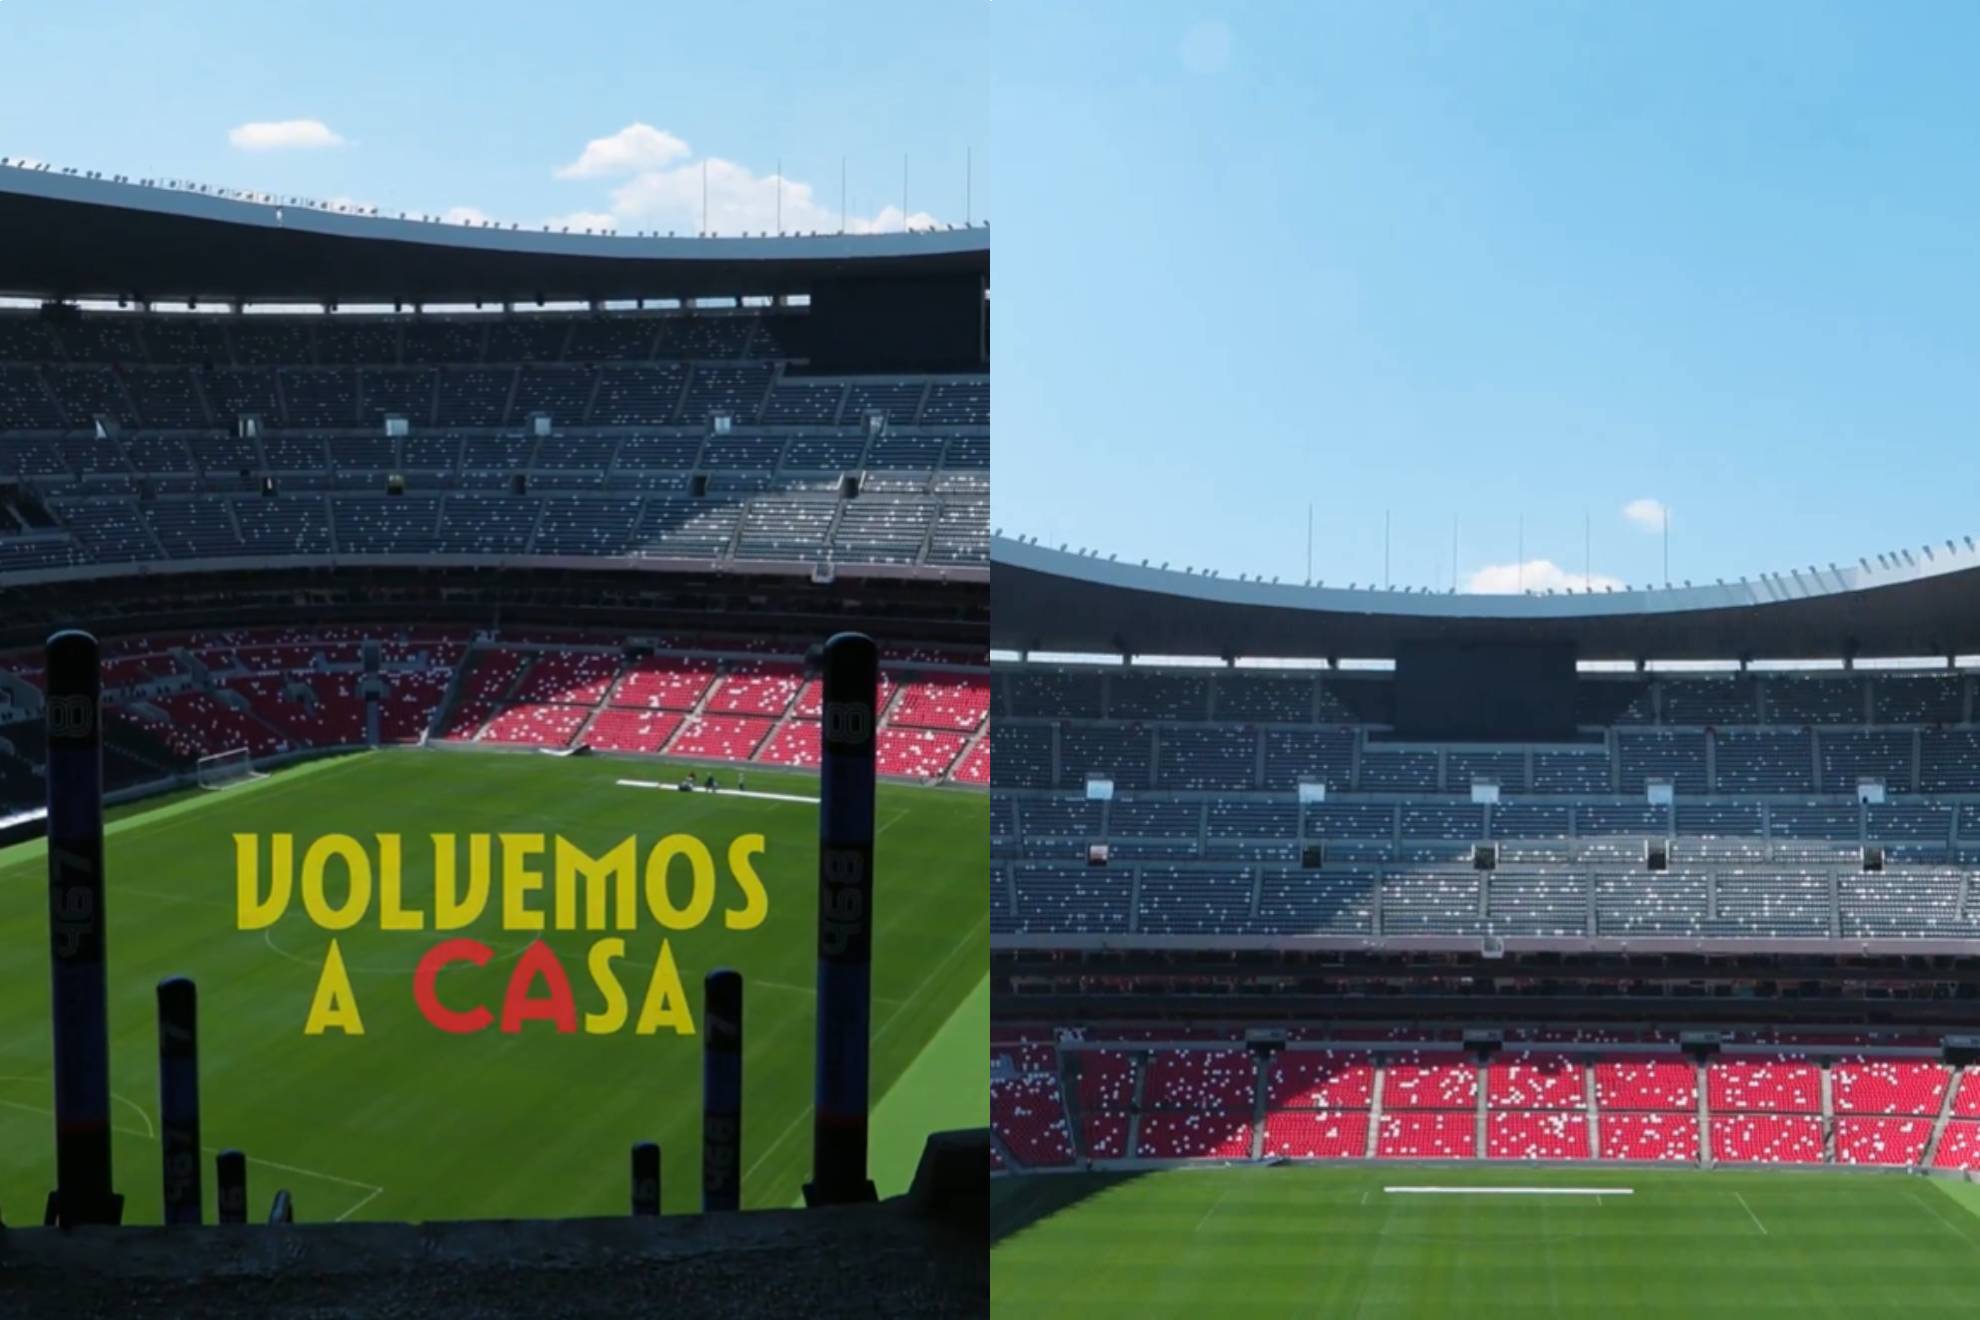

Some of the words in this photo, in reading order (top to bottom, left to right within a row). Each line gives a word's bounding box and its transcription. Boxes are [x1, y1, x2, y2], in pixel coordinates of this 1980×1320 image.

[48, 692, 95, 739] 8
[824, 701, 872, 744] 8
[54, 847, 94, 959] 467
[824, 849, 864, 955] 468
